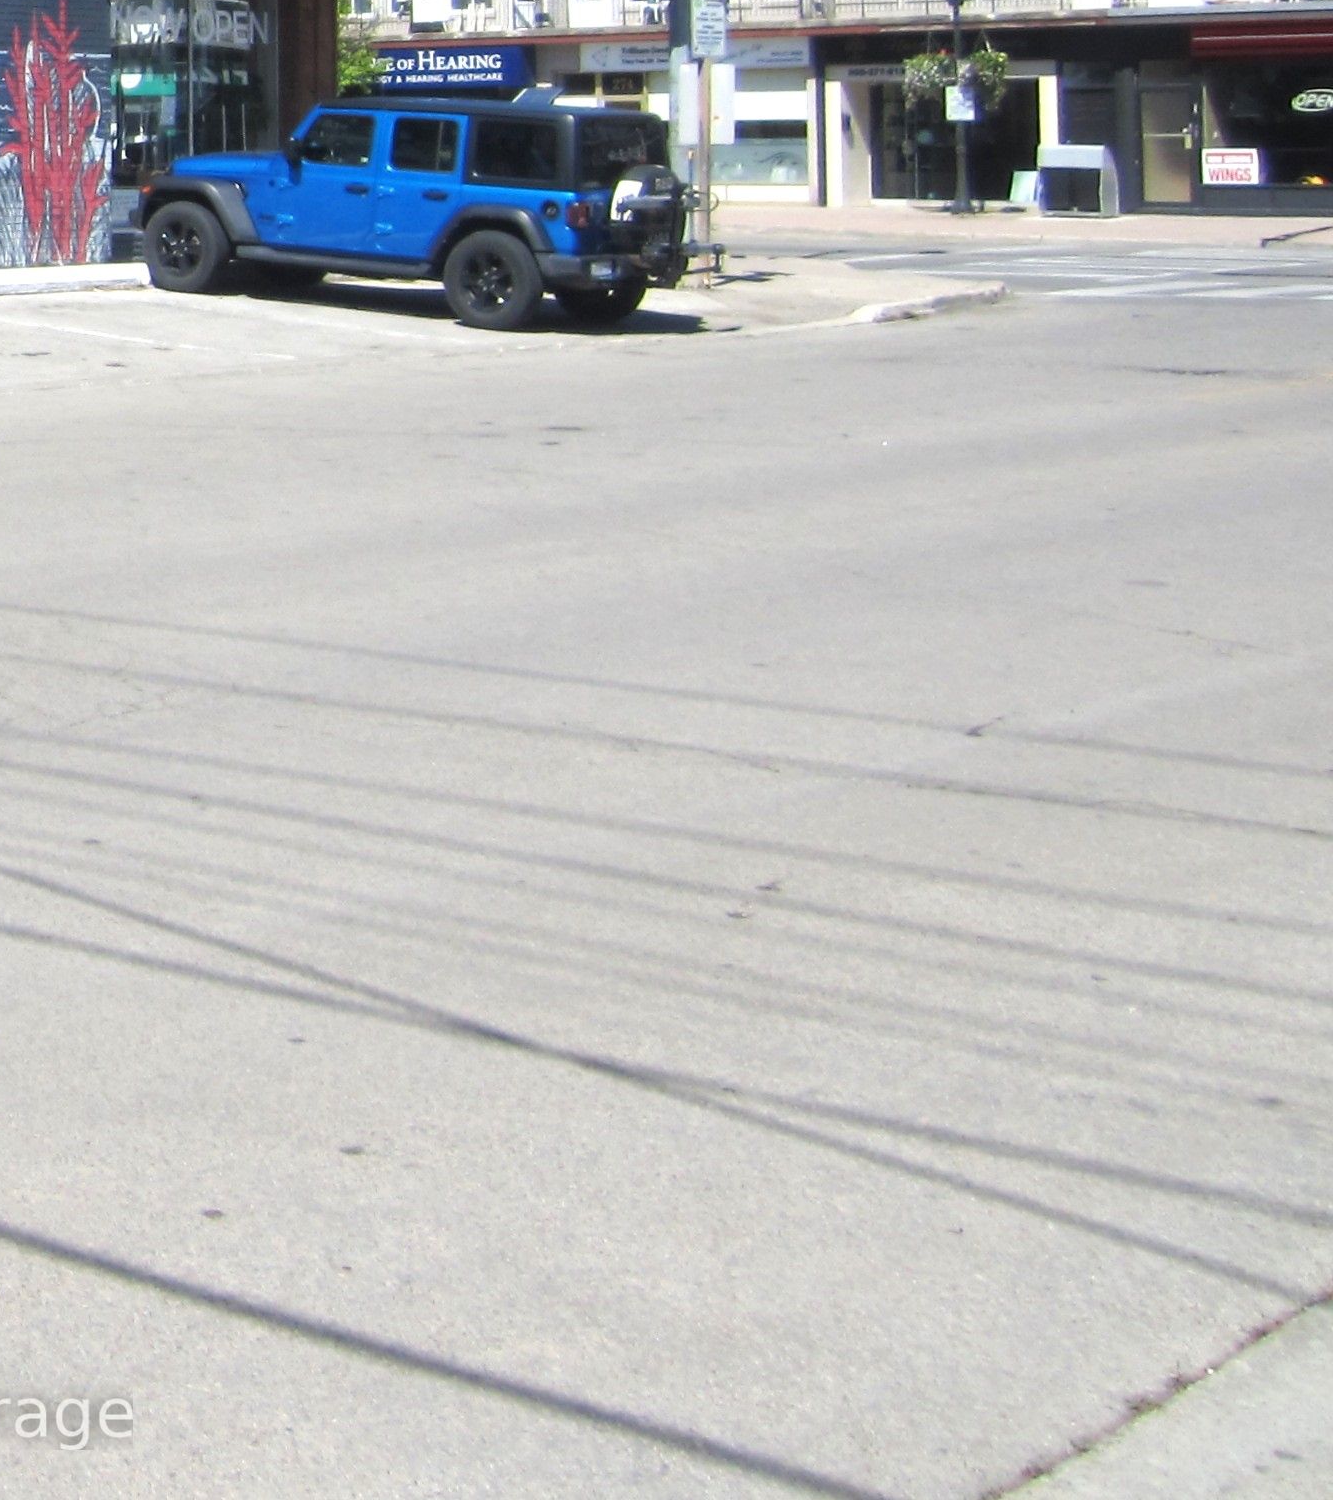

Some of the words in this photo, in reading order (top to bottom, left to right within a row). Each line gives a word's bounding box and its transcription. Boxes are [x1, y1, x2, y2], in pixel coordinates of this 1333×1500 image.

[193, 8, 268, 45] OPEN
[405, 74, 444, 84] HEARING
[447, 72, 503, 83] HEALTHCARE
[1208, 167, 1252, 182] WINGS
